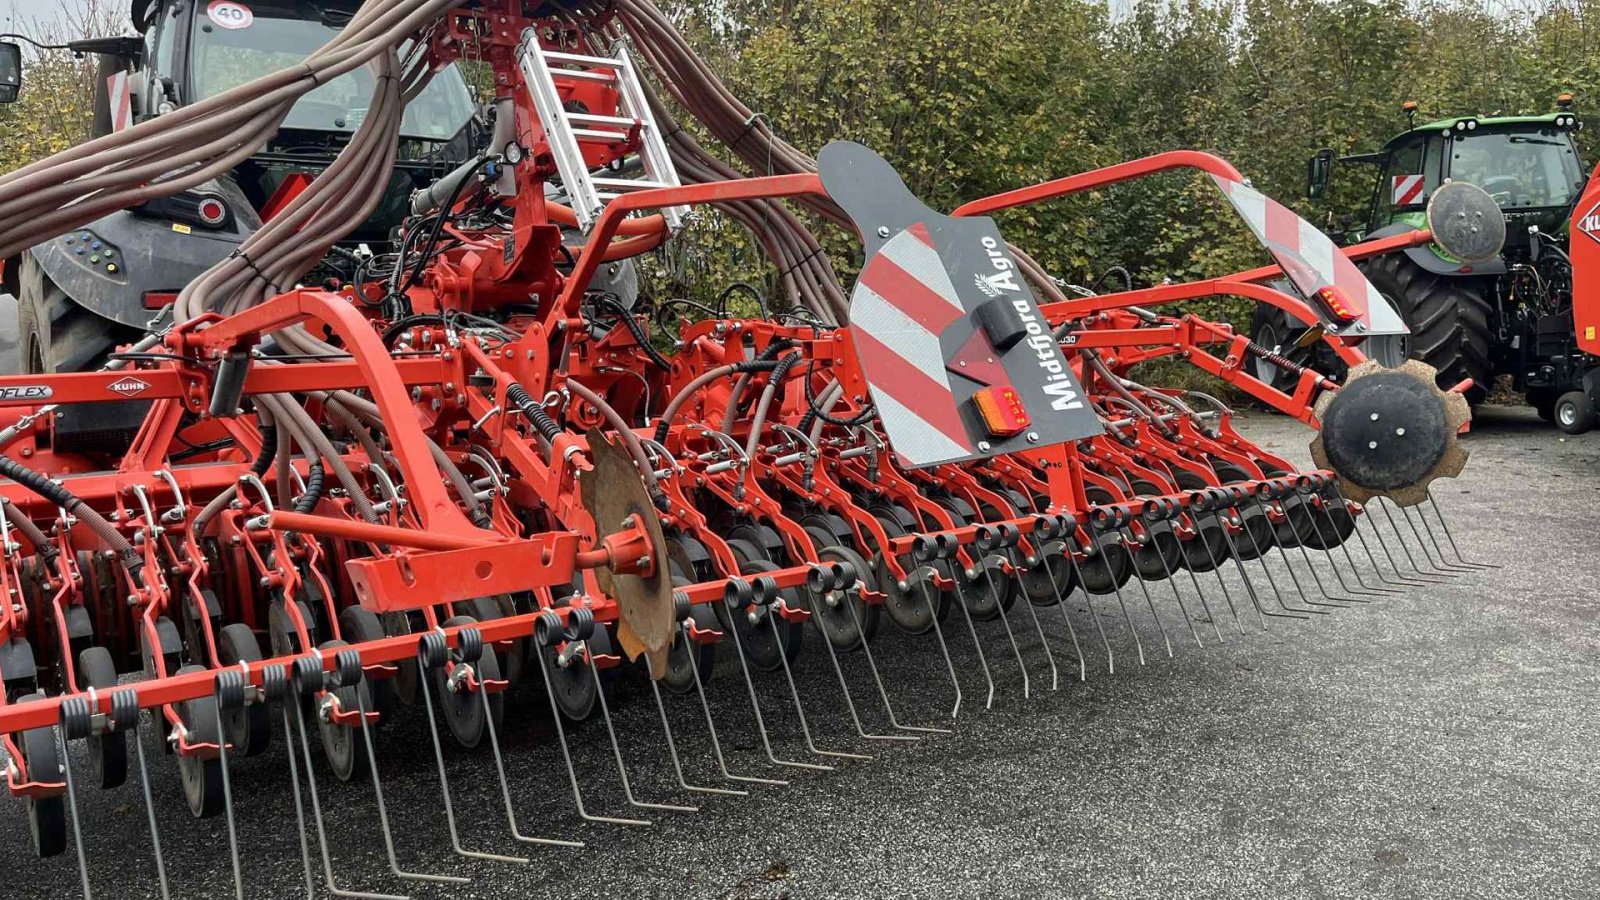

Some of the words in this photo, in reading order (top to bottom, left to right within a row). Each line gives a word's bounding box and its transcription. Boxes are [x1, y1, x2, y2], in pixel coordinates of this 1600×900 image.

[217, 8, 243, 20] 40
[980, 235, 1021, 292] Agro
[114, 382, 145, 391] KUHN
